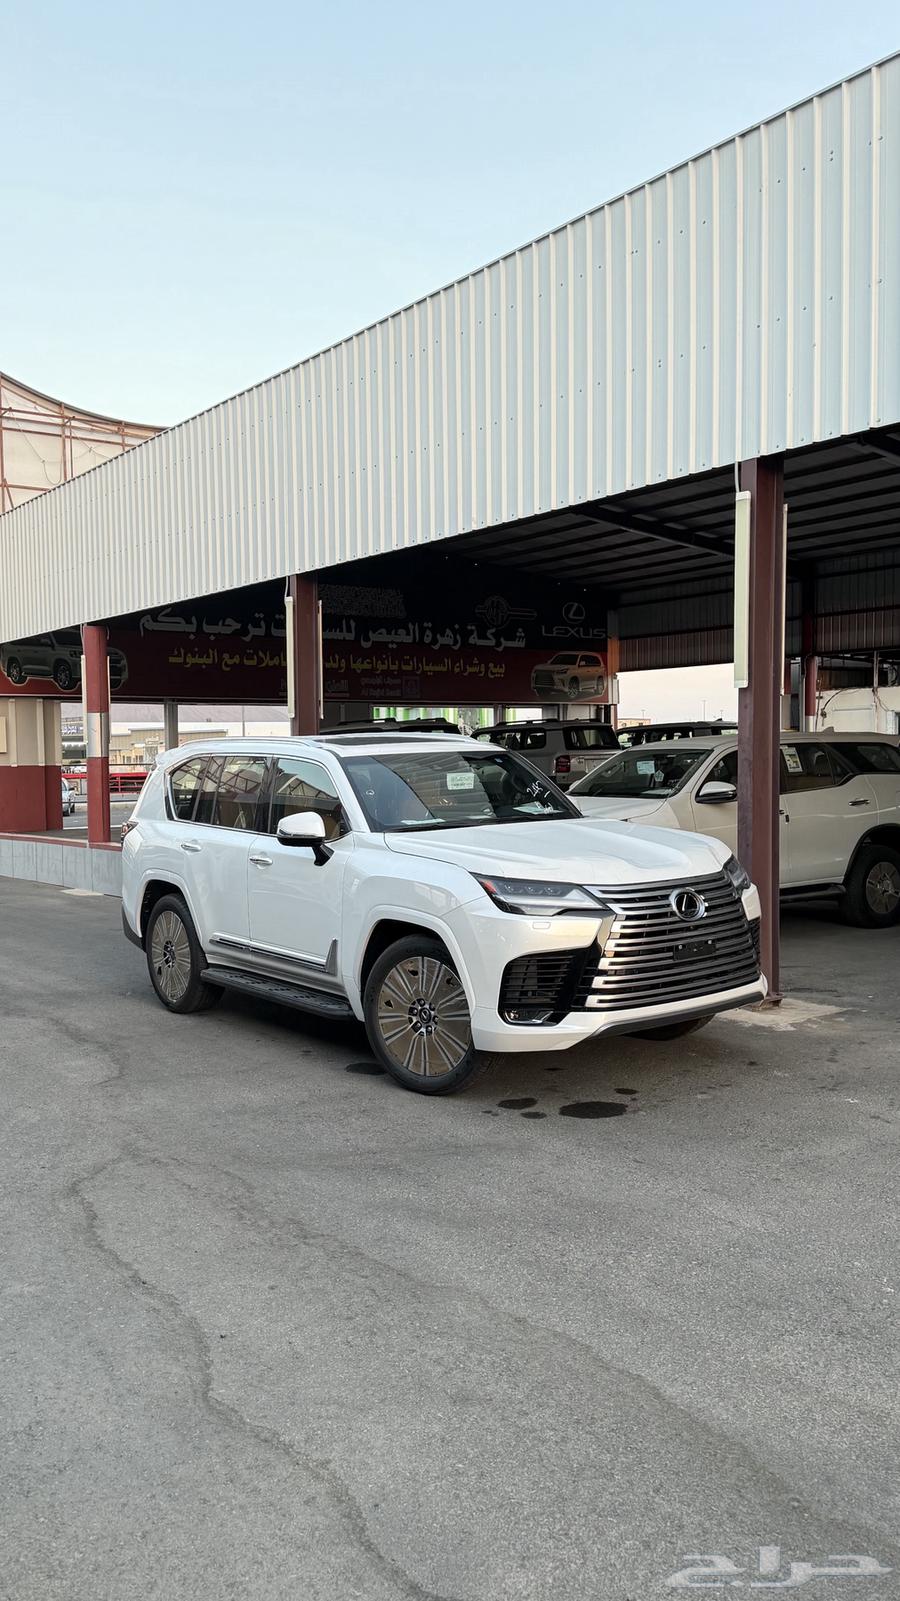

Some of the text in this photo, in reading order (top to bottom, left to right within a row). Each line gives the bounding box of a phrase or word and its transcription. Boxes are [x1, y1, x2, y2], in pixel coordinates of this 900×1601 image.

[139, 607, 198, 640] بكم
[202, 612, 266, 642] ترحب
[541, 624, 608, 640] LEXUS
[360, 621, 420, 648] العيص
[423, 621, 462, 650] زهرة
[466, 624, 527, 651] شركة
[168, 648, 218, 668] البنوك
[220, 654, 241, 671] مع
[401, 655, 451, 675] السيارات
[453, 657, 487, 676] وشراء
[487, 660, 507, 678] بيع
